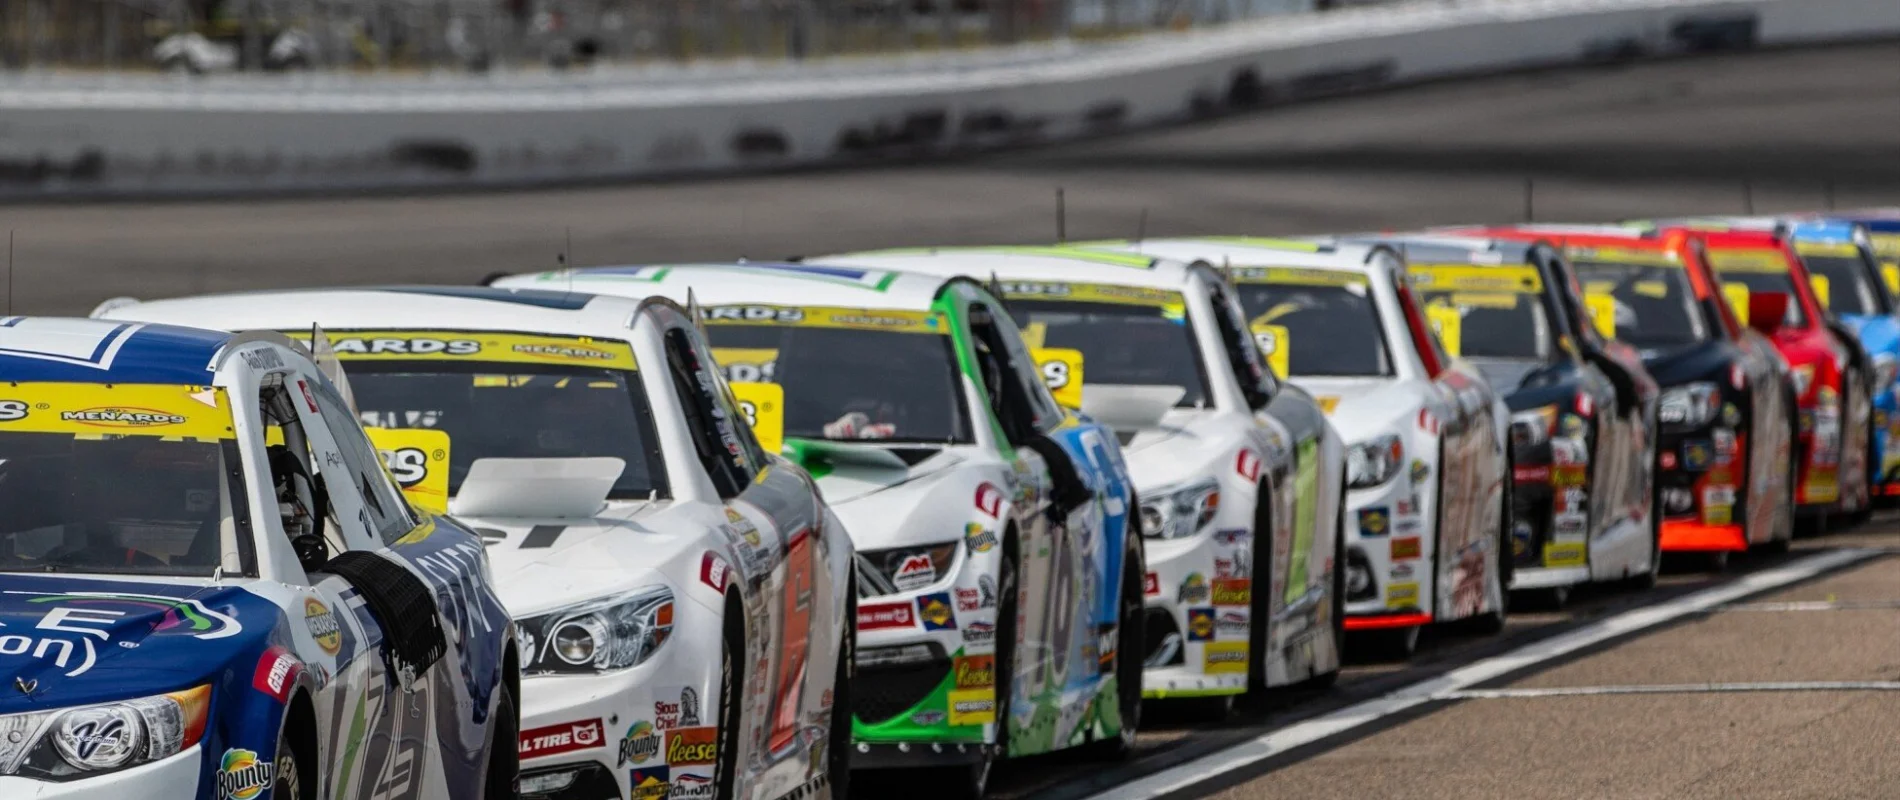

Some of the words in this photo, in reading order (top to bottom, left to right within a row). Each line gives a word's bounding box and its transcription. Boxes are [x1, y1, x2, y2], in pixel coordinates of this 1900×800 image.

[330, 338, 482, 354] ARDS
[512, 344, 616, 360] MENARDS
[61, 411, 186, 424] MENARDS
[655, 701, 679, 714] Sioux
[655, 714, 679, 731] Chief
[532, 732, 573, 749] TIRE
[617, 729, 663, 769] Bounty
[217, 761, 273, 800] Bounty
